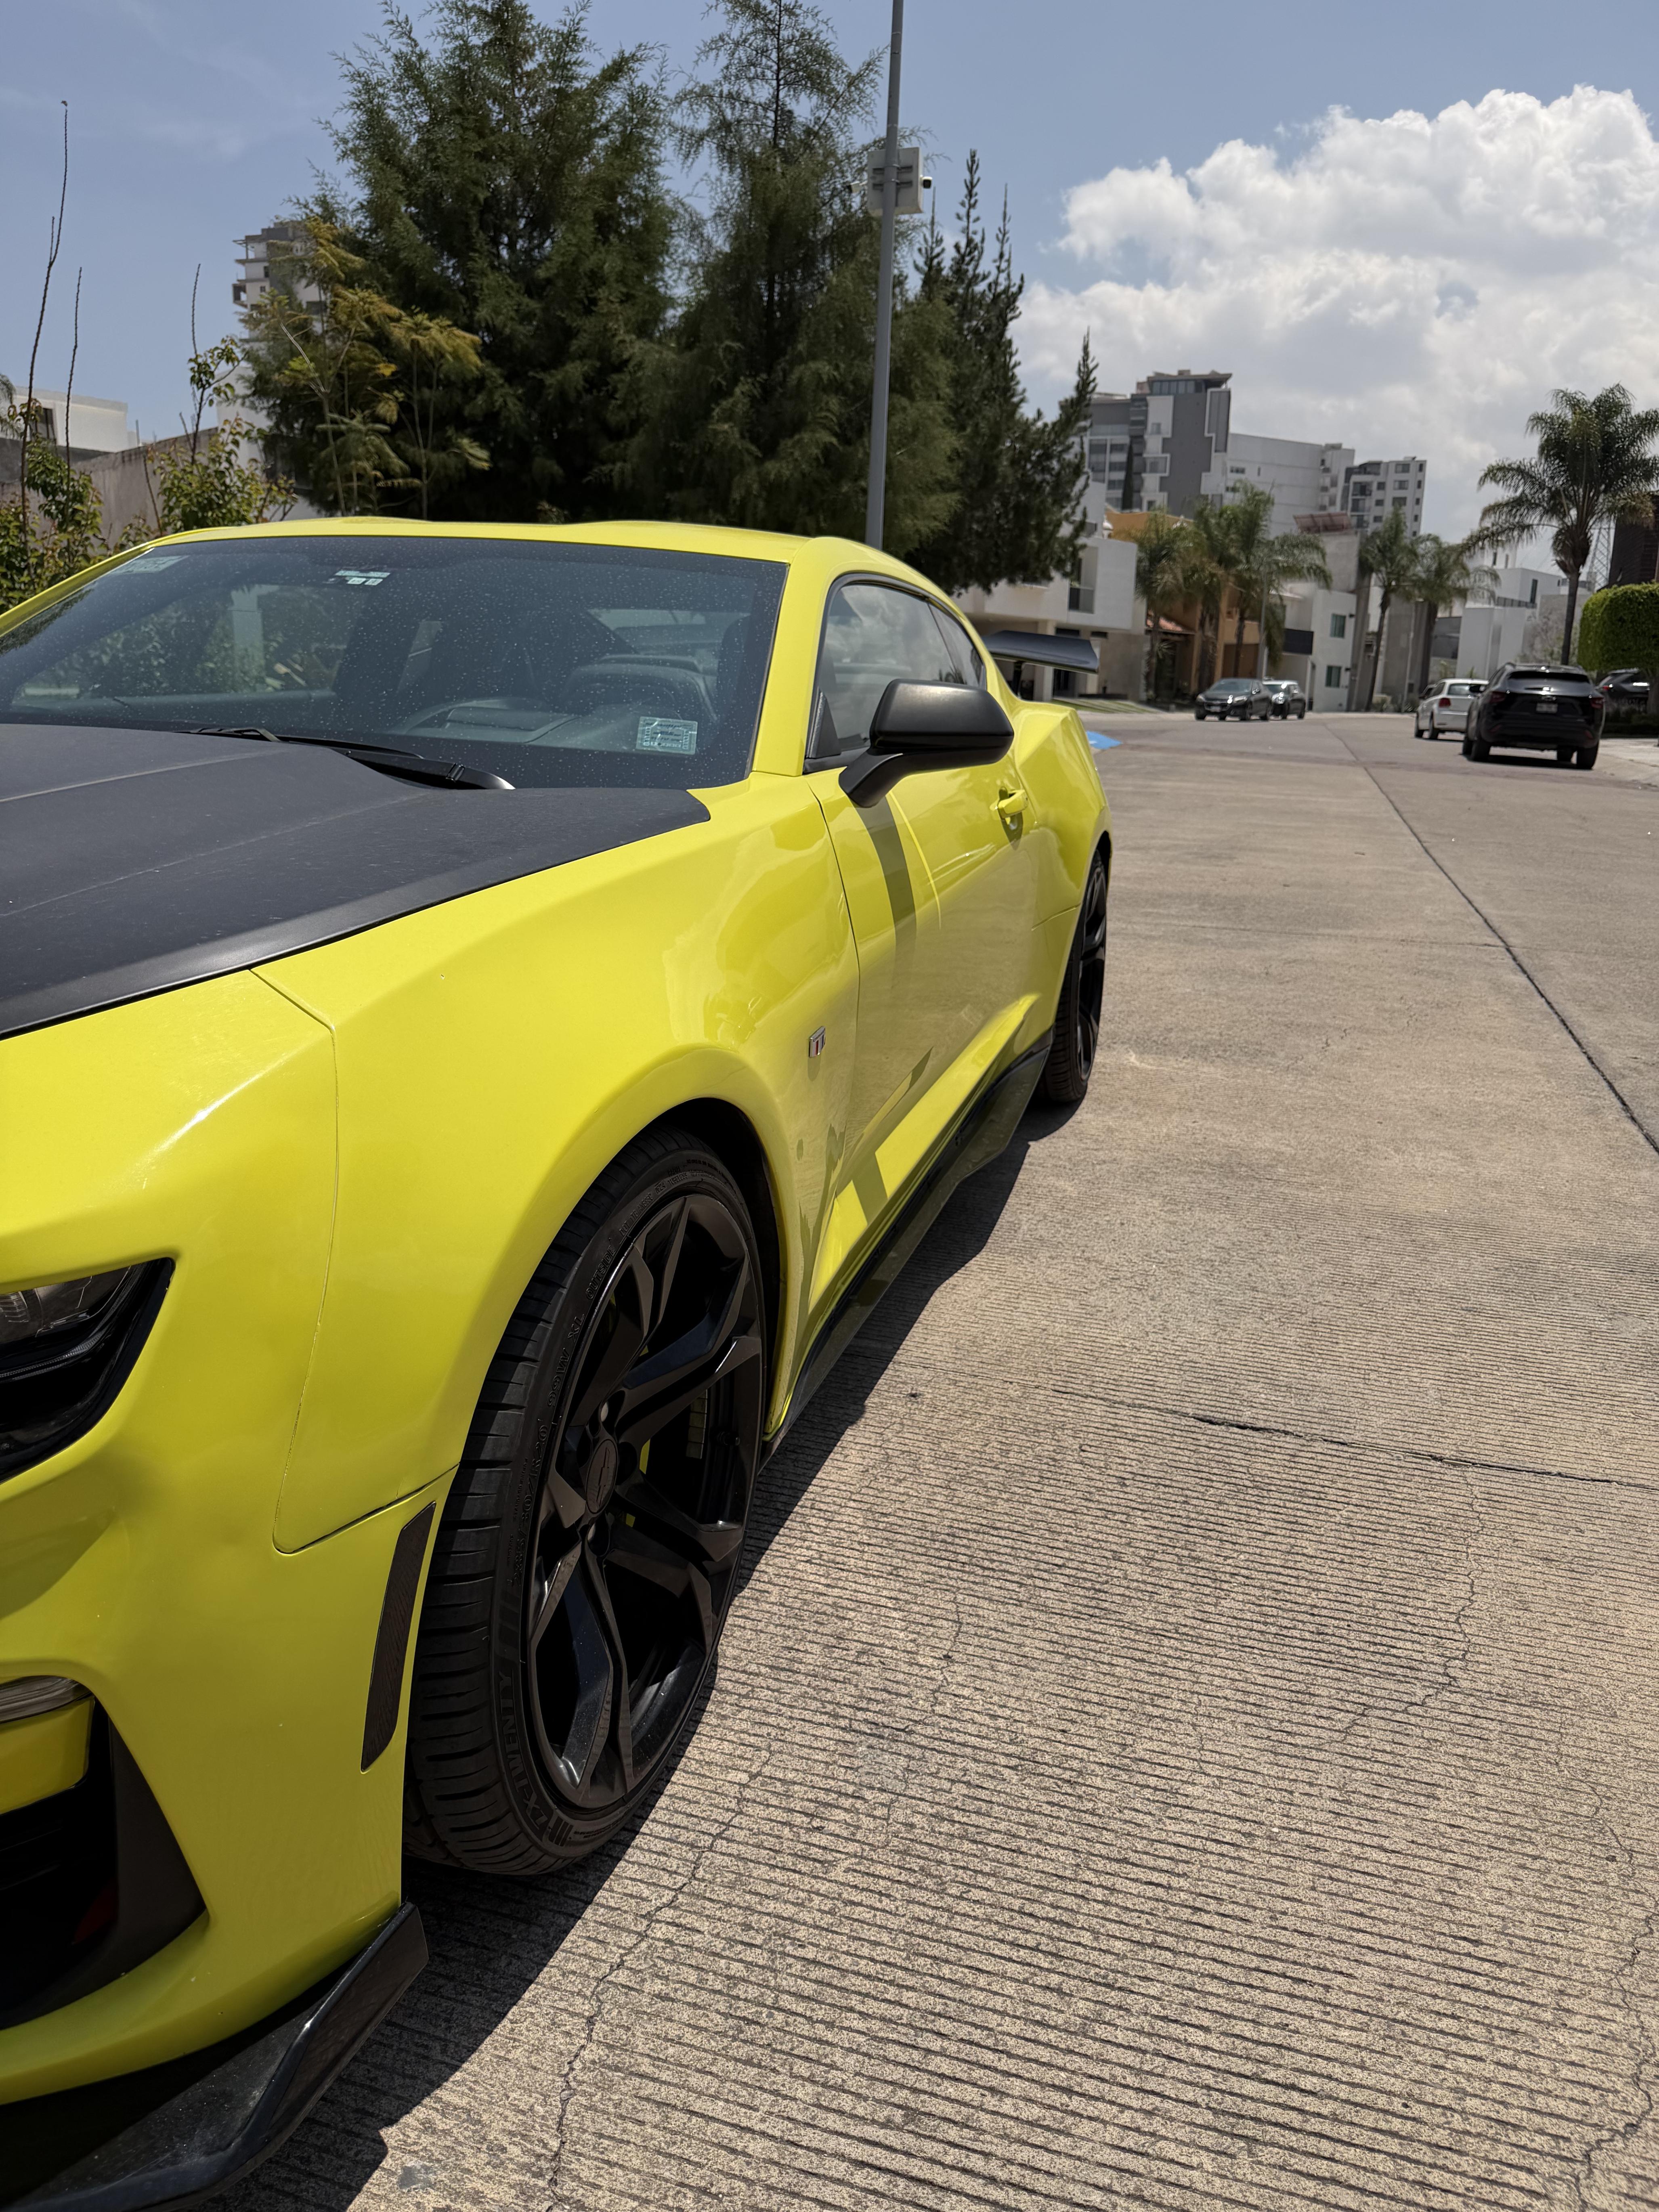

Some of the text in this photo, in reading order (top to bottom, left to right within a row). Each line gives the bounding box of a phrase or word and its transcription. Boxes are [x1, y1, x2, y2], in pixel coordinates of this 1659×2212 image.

[619, 1220, 630, 1237] DOT
[585, 1245, 616, 1300] OUTSIDE
[547, 1347, 570, 1407] 99W
[567, 1313, 585, 1342] XL
[499, 1670, 548, 1830] LX-TWENTY
